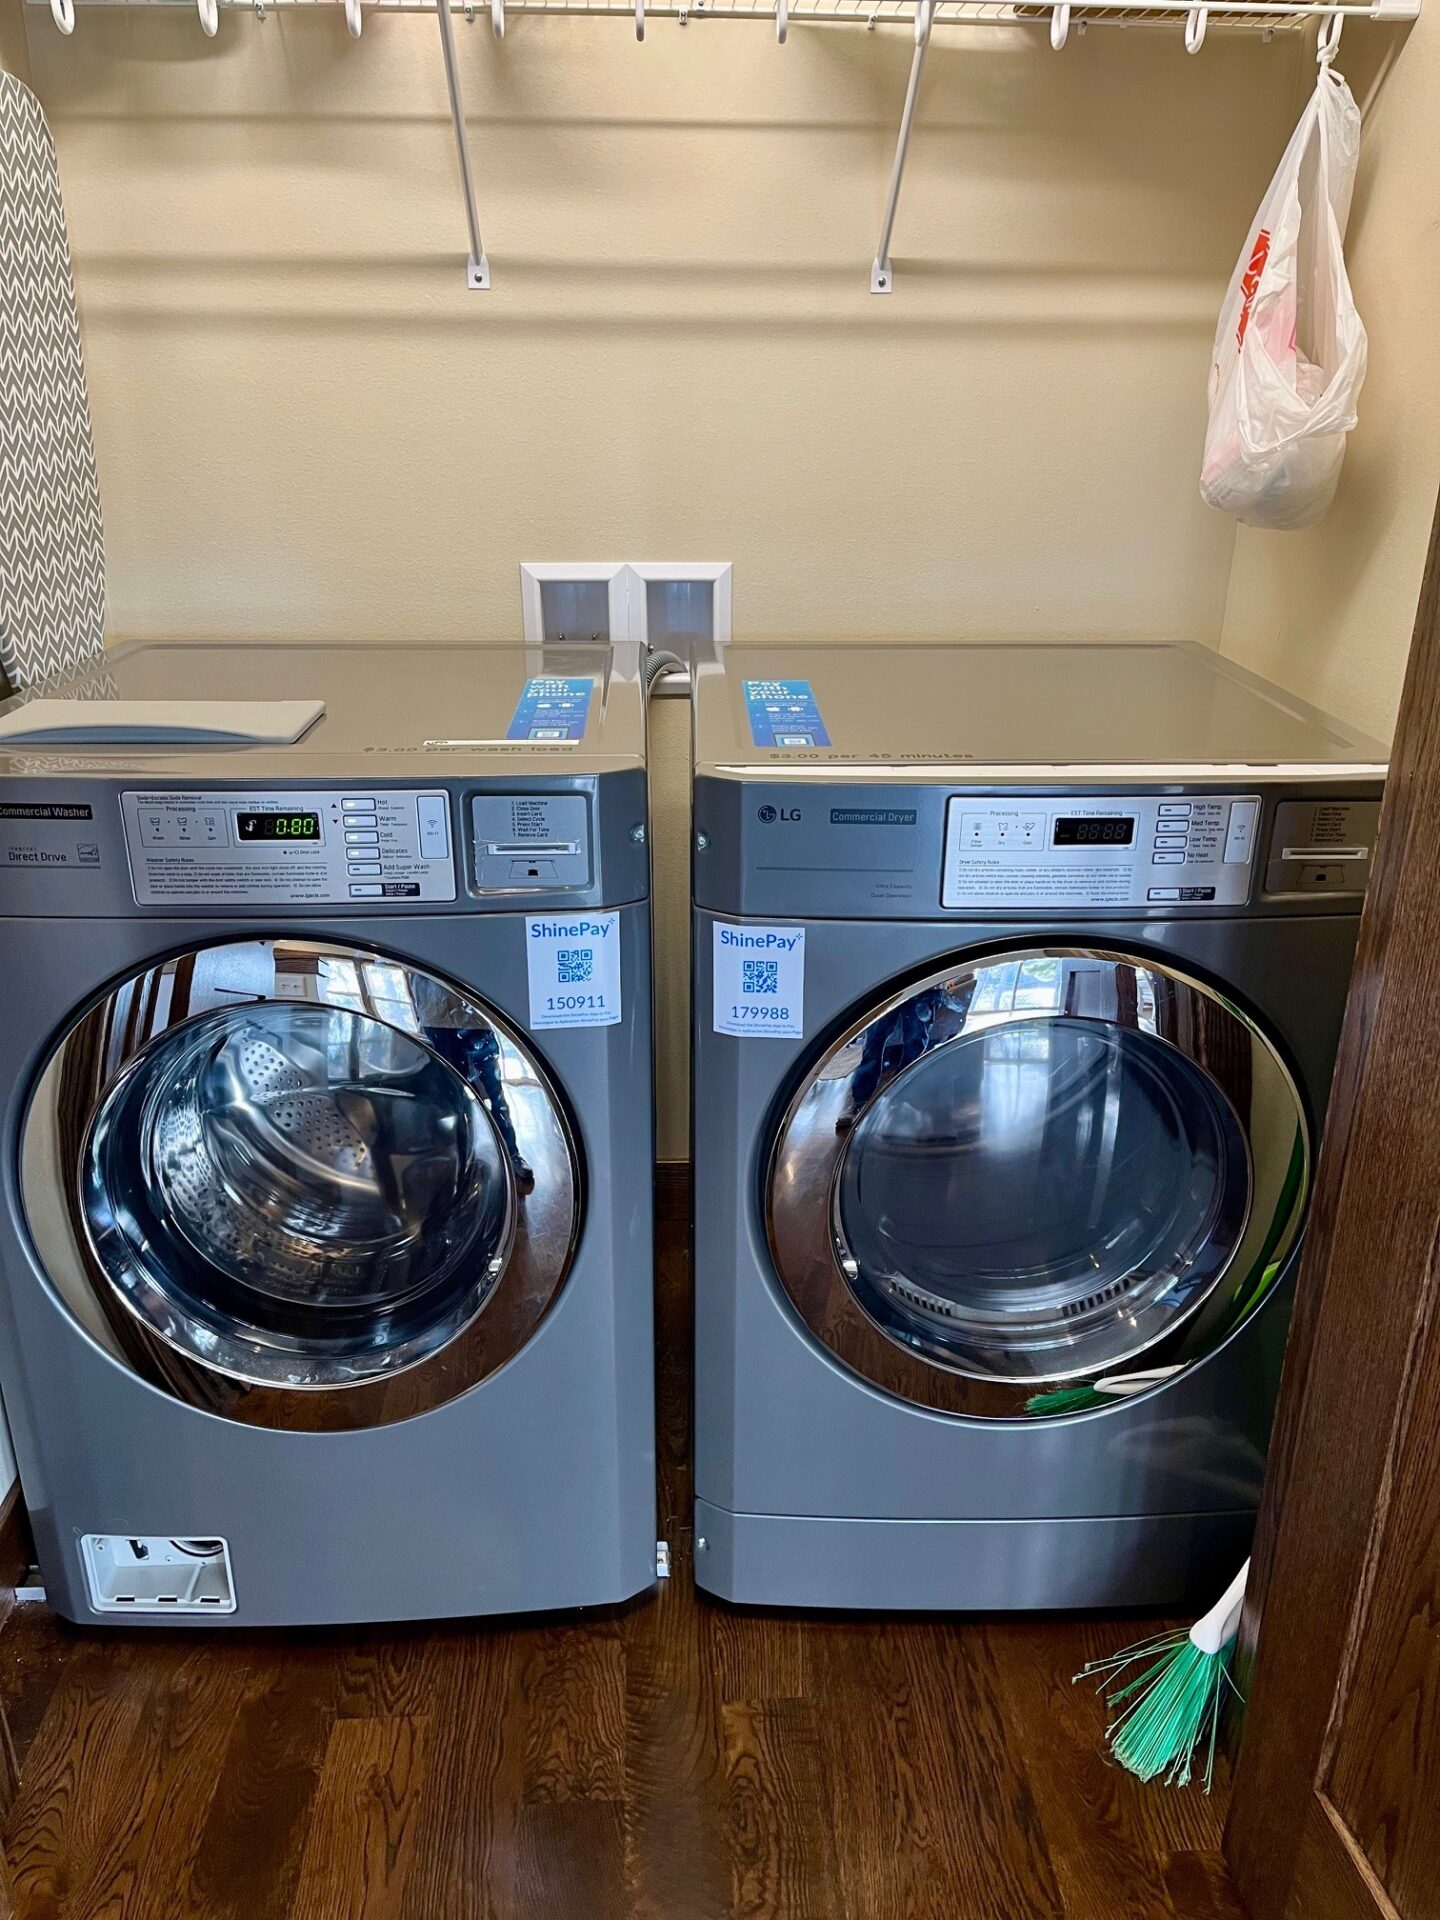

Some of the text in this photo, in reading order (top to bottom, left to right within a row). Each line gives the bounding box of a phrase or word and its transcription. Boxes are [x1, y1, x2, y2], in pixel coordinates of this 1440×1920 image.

[52, 807, 88, 817] Washer
[780, 808, 914, 823] LG Commercial Dryer
[8, 852, 38, 861] Direct
[40, 852, 66, 862] Drive
[531, 922, 610, 938] ShinePay
[721, 930, 796, 952] ShinePay
[547, 995, 606, 1010] 150911
[732, 1006, 790, 1020] 179988
